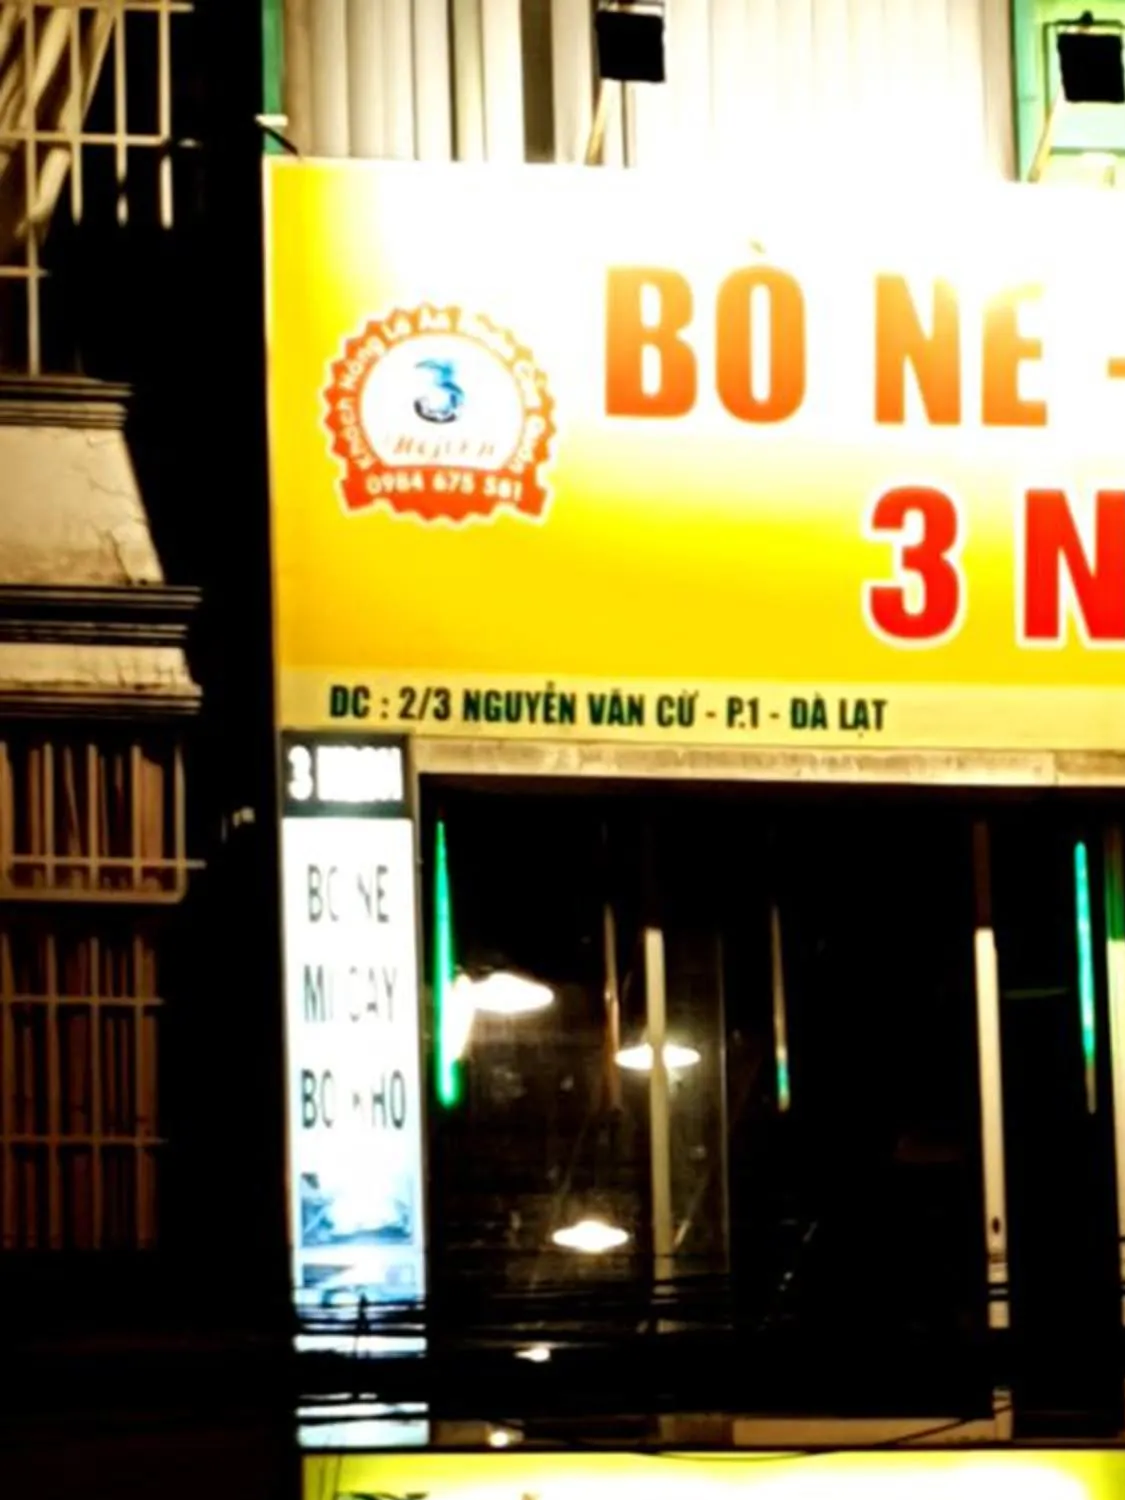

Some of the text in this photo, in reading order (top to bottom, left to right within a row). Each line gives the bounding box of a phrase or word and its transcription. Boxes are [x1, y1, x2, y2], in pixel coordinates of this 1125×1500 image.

[867, 484, 962, 640] 3
[398, 686, 451, 721] 2/3
[726, 696, 760, 730] P.1
